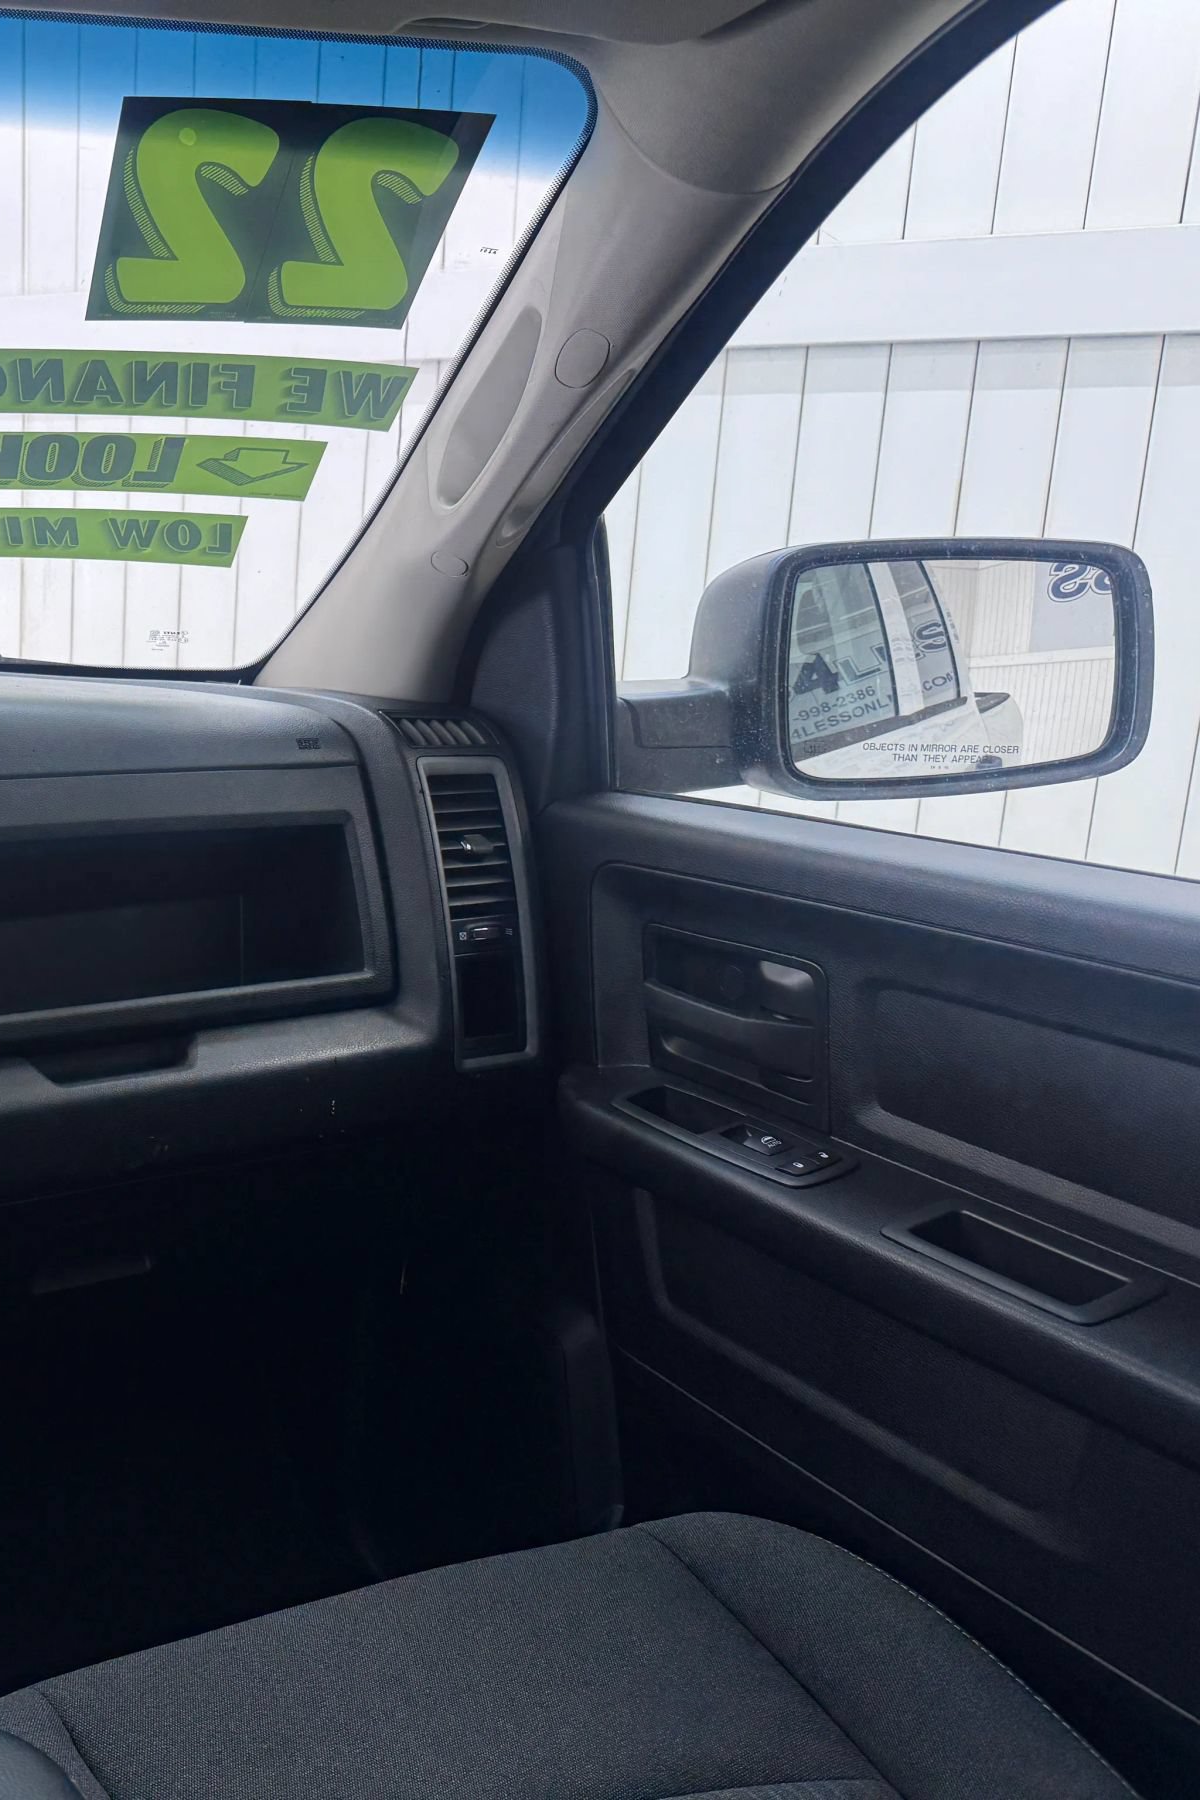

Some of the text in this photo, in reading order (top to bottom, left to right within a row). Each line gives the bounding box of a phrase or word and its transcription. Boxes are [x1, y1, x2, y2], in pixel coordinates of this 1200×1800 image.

[862, 742, 1019, 754] OBJECTS IN MIRROR ARE CLOSER
[892, 753, 918, 762] THAN
[923, 754, 947, 763] THEY
